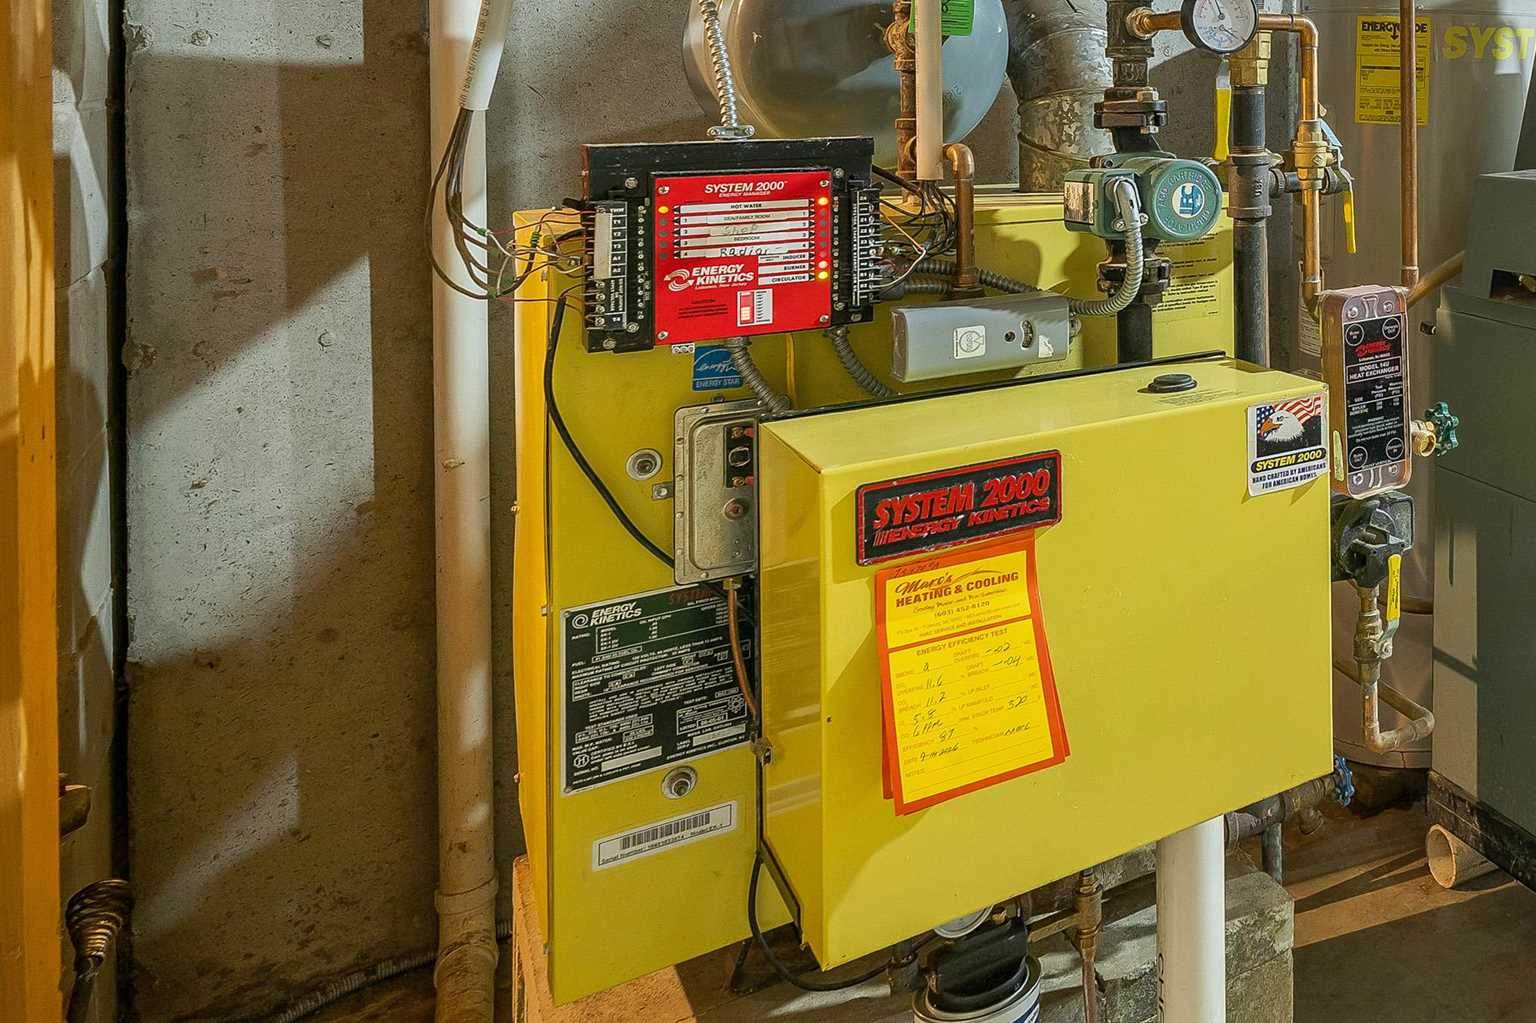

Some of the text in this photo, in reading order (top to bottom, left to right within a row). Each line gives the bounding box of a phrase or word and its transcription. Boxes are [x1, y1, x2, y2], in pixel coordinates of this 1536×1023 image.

[1361, 21, 1428, 33] ENERGYDE
[704, 181, 785, 194] SYSTEM 2000
[692, 263, 744, 276] ENERGY
[696, 271, 754, 286] KINETICS
[771, 275, 807, 283] CIRCULATOR
[1349, 365, 1400, 380] HEAT EXCHANGER
[1359, 363, 1379, 372] MODEL
[1255, 449, 1322, 472] SYSTEM 2000
[1252, 462, 1327, 484] HAND CRAFTED BY AMERICANS
[1273, 475, 1299, 487] AMERICAN
[874, 468, 1051, 530] SYSTEM 2000
[886, 495, 1050, 545] ENERGY KINETICS
[895, 573, 953, 596] Marc's
[896, 586, 953, 608] HEATING
[954, 584, 963, 595] &
[966, 571, 1020, 593] COOLING
[589, 607, 642, 628] KINETICS
[591, 601, 636, 620] ENERGY
[915, 627, 1009, 656] ENERGY EFFICIENCY TEST
